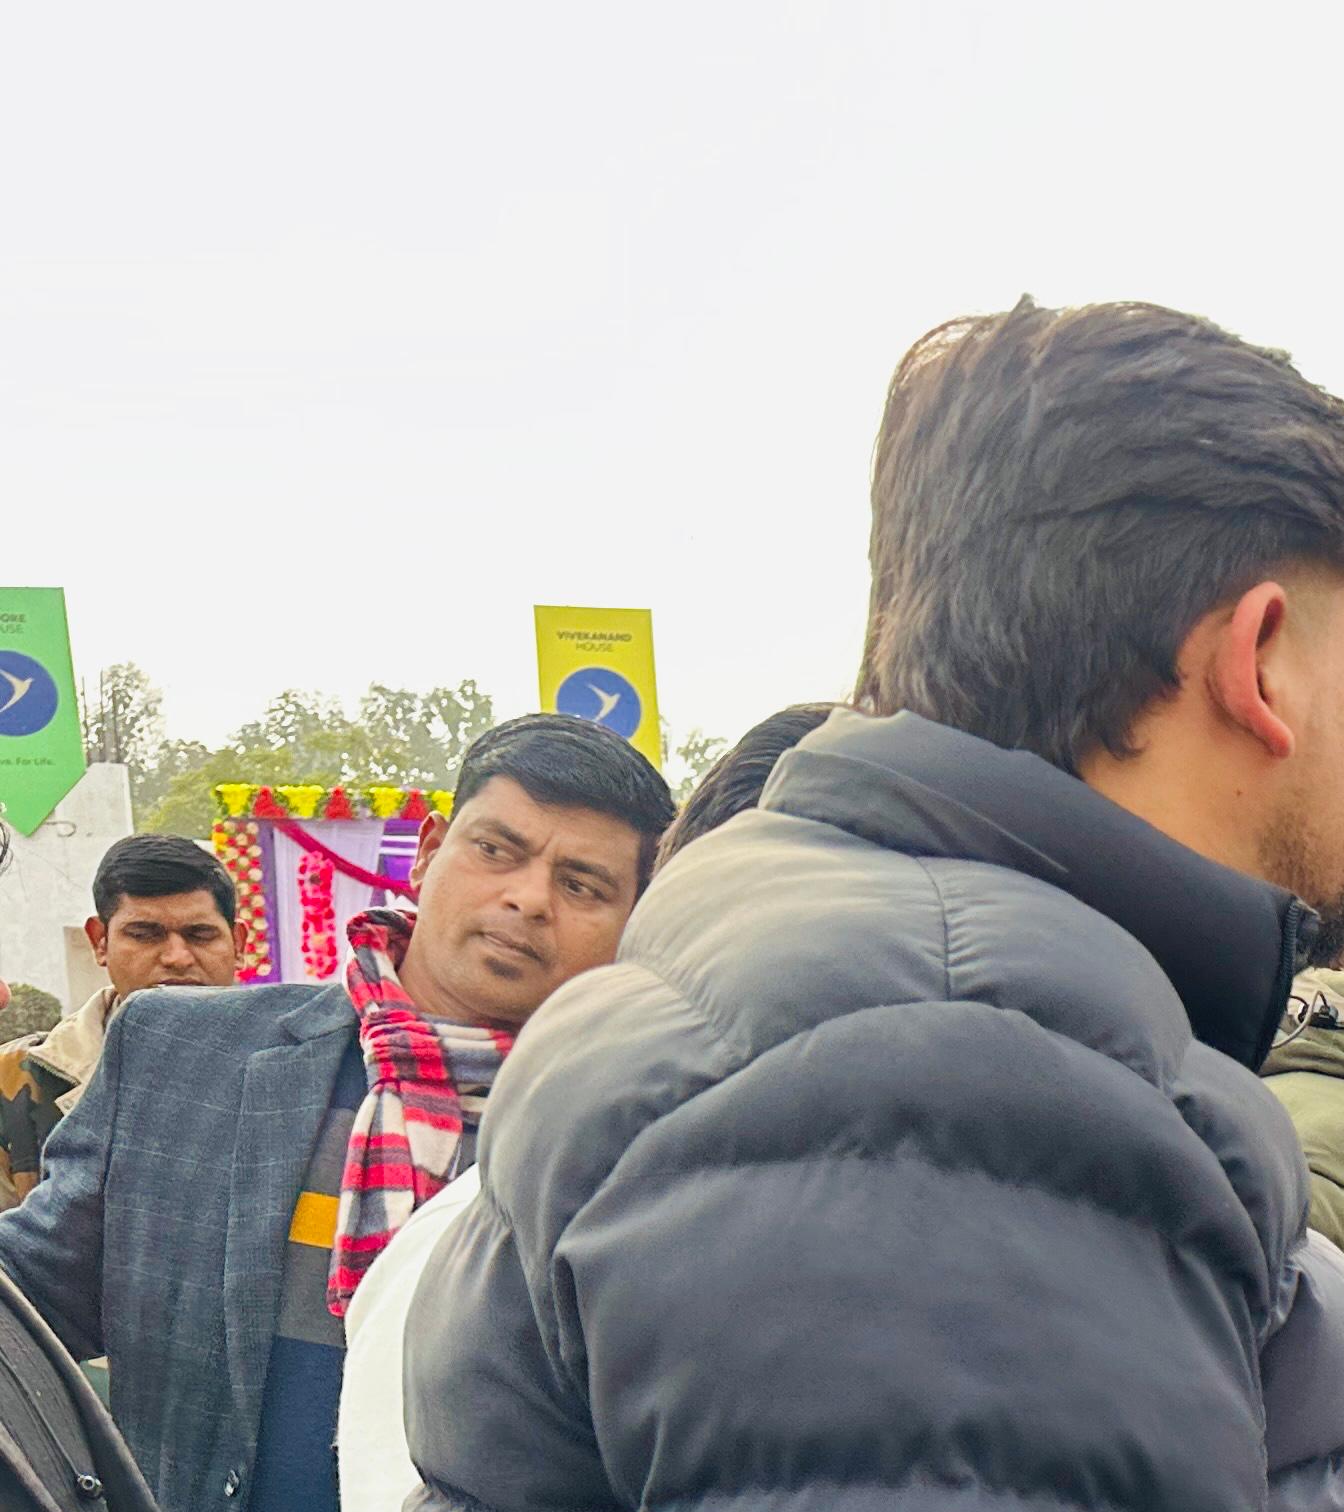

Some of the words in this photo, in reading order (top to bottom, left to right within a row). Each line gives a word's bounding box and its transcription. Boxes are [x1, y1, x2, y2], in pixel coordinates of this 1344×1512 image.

[0, 613, 26, 623] ORE
[0, 624, 24, 634] USE
[557, 631, 632, 643] VIVEKANAND
[576, 642, 613, 652] HOUSE
